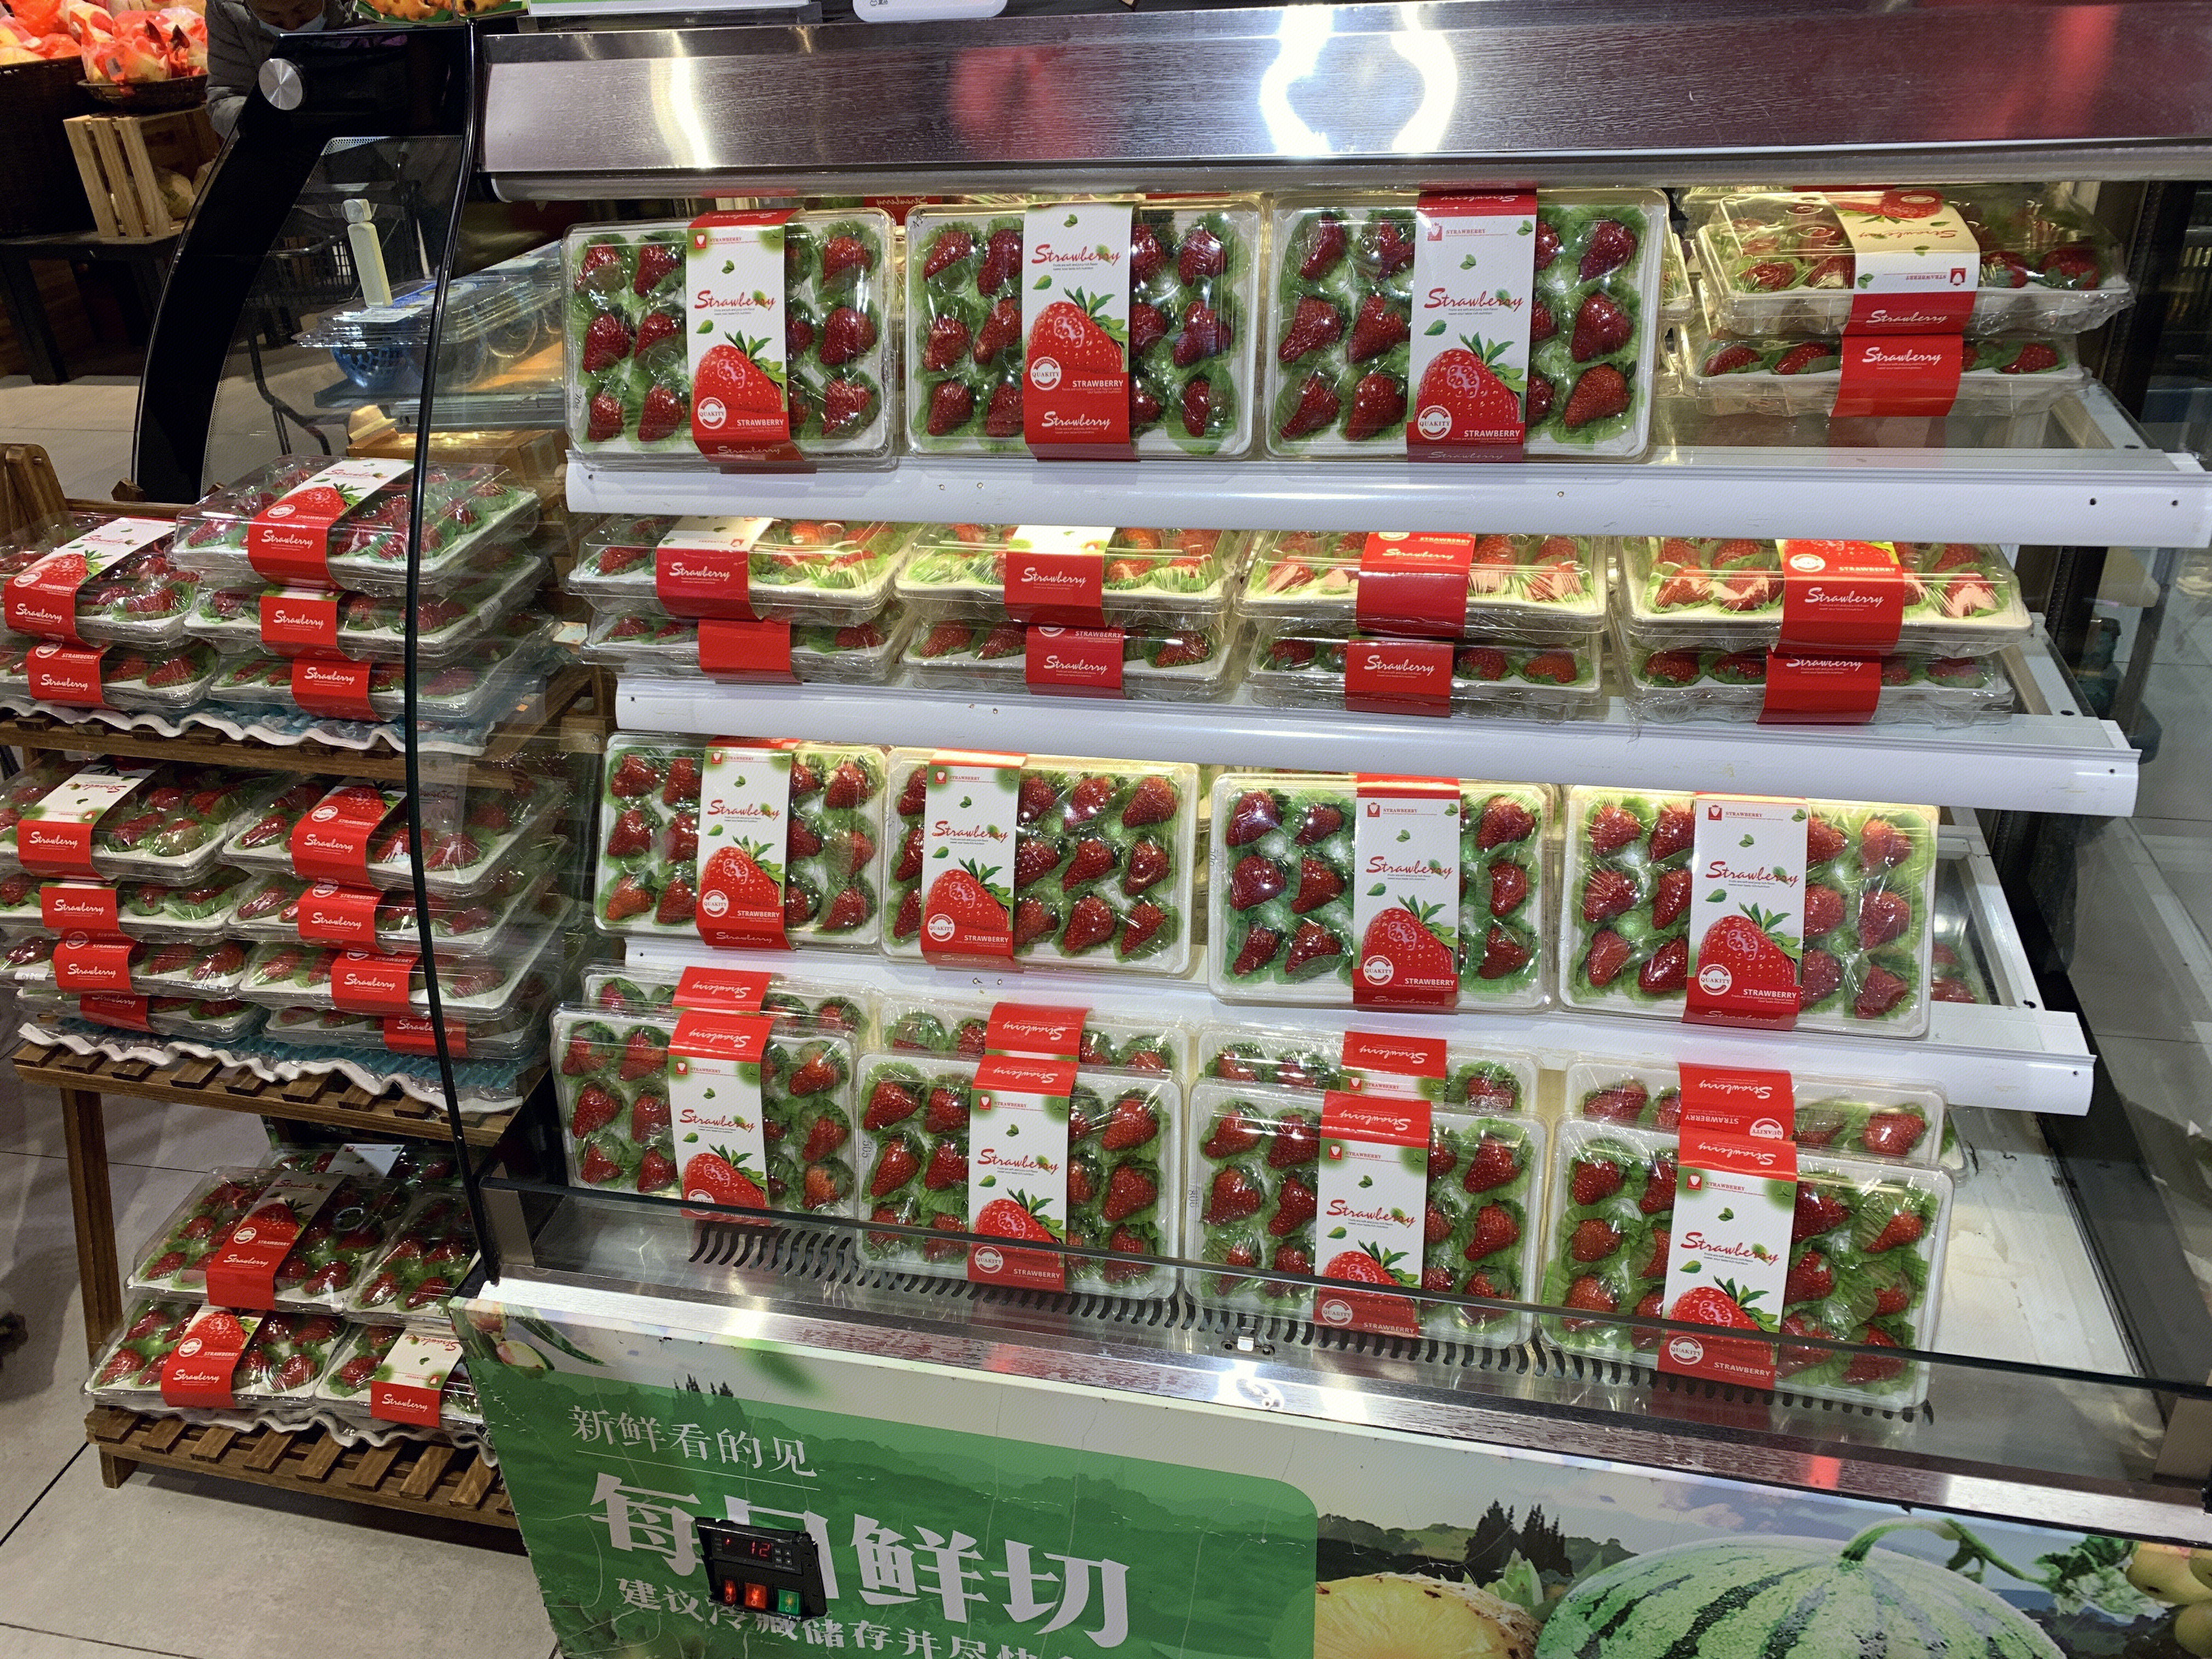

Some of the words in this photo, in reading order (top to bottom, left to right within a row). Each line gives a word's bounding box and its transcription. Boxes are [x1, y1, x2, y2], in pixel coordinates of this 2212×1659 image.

[1031, 243, 1121, 266] Strawberry
[694, 290, 777, 311] Strawberry
[1424, 287, 1525, 312] Strawberry
[1866, 309, 1948, 324] Strawberry
[1862, 347, 1943, 366] Strawberry
[1041, 411, 1111, 430] Strawberry
[717, 445, 780, 455] Strawberry
[1427, 451, 1505, 460] Strawberry
[261, 529, 314, 549] Strawberry
[1382, 548, 1454, 560] Strawberry
[669, 562, 730, 582] Strawberry
[1021, 567, 1087, 588] Strawberry
[38, 583, 74, 592] STRAWBERRY
[1804, 587, 1884, 608] Strawberry
[15, 603, 63, 624] Strawberry
[273, 610, 325, 630] Strawberry
[1075, 630, 1122, 639] STRAWBERRY
[1043, 655, 1108, 675] Strawberry
[1364, 654, 1436, 676] Strawberry
[40, 674, 89, 692] Strawberry
[304, 667, 356, 686] Strawberry
[707, 799, 781, 821] Strawberry
[337, 819, 376, 827] STRAWBERRY
[932, 820, 1009, 844] Strawberry
[29, 830, 78, 849] Strawberry
[304, 833, 354, 854] Strawberry
[1366, 855, 1453, 880] Strawberry
[1706, 861, 1800, 888] Strawberry
[53, 899, 104, 917] Strawberry
[311, 912, 362, 930] Strawberry
[716, 932, 773, 943] Strawberry
[67, 963, 117, 979] Strawberry
[343, 973, 396, 991] Strawberry
[692, 980, 752, 999] Strawberry
[1404, 978, 1455, 986] STRAWBERRY
[1372, 996, 1440, 1006] Strawberry
[1743, 989, 1797, 998] STRAWBERRY
[1705, 1011, 1778, 1024] Strawberry
[688, 1028, 752, 1048] Strawberry
[1002, 1020, 1066, 1041] Strawberry
[1358, 1045, 1429, 1064] Strawberry
[993, 1066, 1058, 1084] Strawberry
[1699, 1080, 1773, 1099] Strawberry
[679, 1109, 756, 1133] Strawberry
[1339, 1109, 1412, 1131] Strawberry
[1685, 1115, 1739, 1125] STRAWBERRY
[977, 1148, 1059, 1175] Strawberry
[1698, 1142, 1777, 1166] Strawberry
[1706, 1182, 1746, 1191] STRAWBERRY
[1326, 1199, 1416, 1228] Strawberry
[1680, 1232, 1780, 1266] Strawberry
[223, 1254, 269, 1268] Strawberry
[1013, 1268, 1060, 1279] STRAWBERRY
[1363, 1322, 1414, 1334] STRAWBERRY
[1671, 1346, 1702, 1356] QUAKITY
[173, 1369, 220, 1384] Strawberry
[1714, 1362, 1771, 1377] STRAWBERRY
[381, 1393, 428, 1413] Strawberry
[568, 1404, 817, 1477] 新鲜看的见
[751, 1541, 771, 1558] 12
